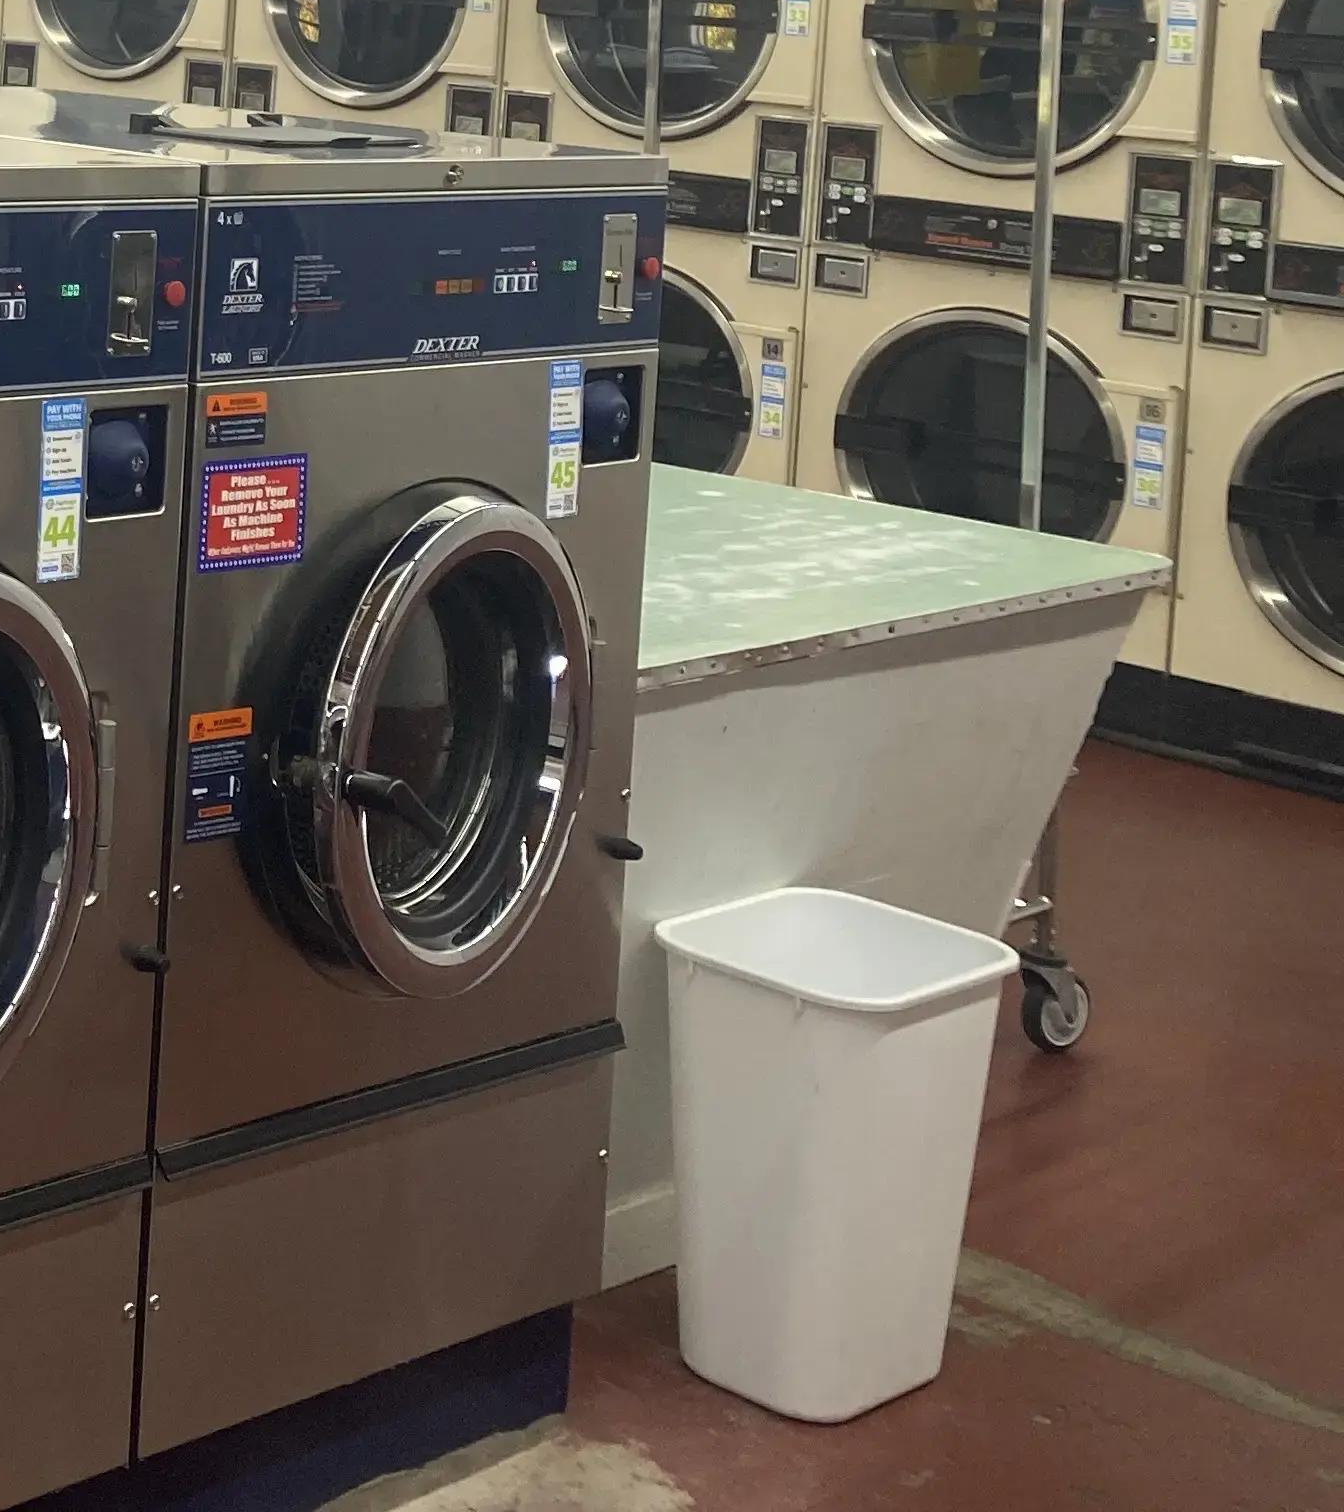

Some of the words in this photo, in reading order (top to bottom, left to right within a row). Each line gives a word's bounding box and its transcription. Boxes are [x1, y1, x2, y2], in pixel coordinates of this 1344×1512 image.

[217, 211, 224, 225] 4
[222, 293, 263, 305] DEXTER
[413, 335, 480, 354] DEXTER
[550, 459, 576, 488] 45
[221, 488, 263, 502] Remove
[265, 486, 288, 497] Your
[212, 503, 253, 516] Laundry
[255, 502, 267, 512] As
[270, 498, 295, 509] Soon
[223, 517, 236, 529] As
[239, 512, 283, 526] Machine
[44, 514, 76, 548] 44
[231, 526, 275, 541] Finishes
